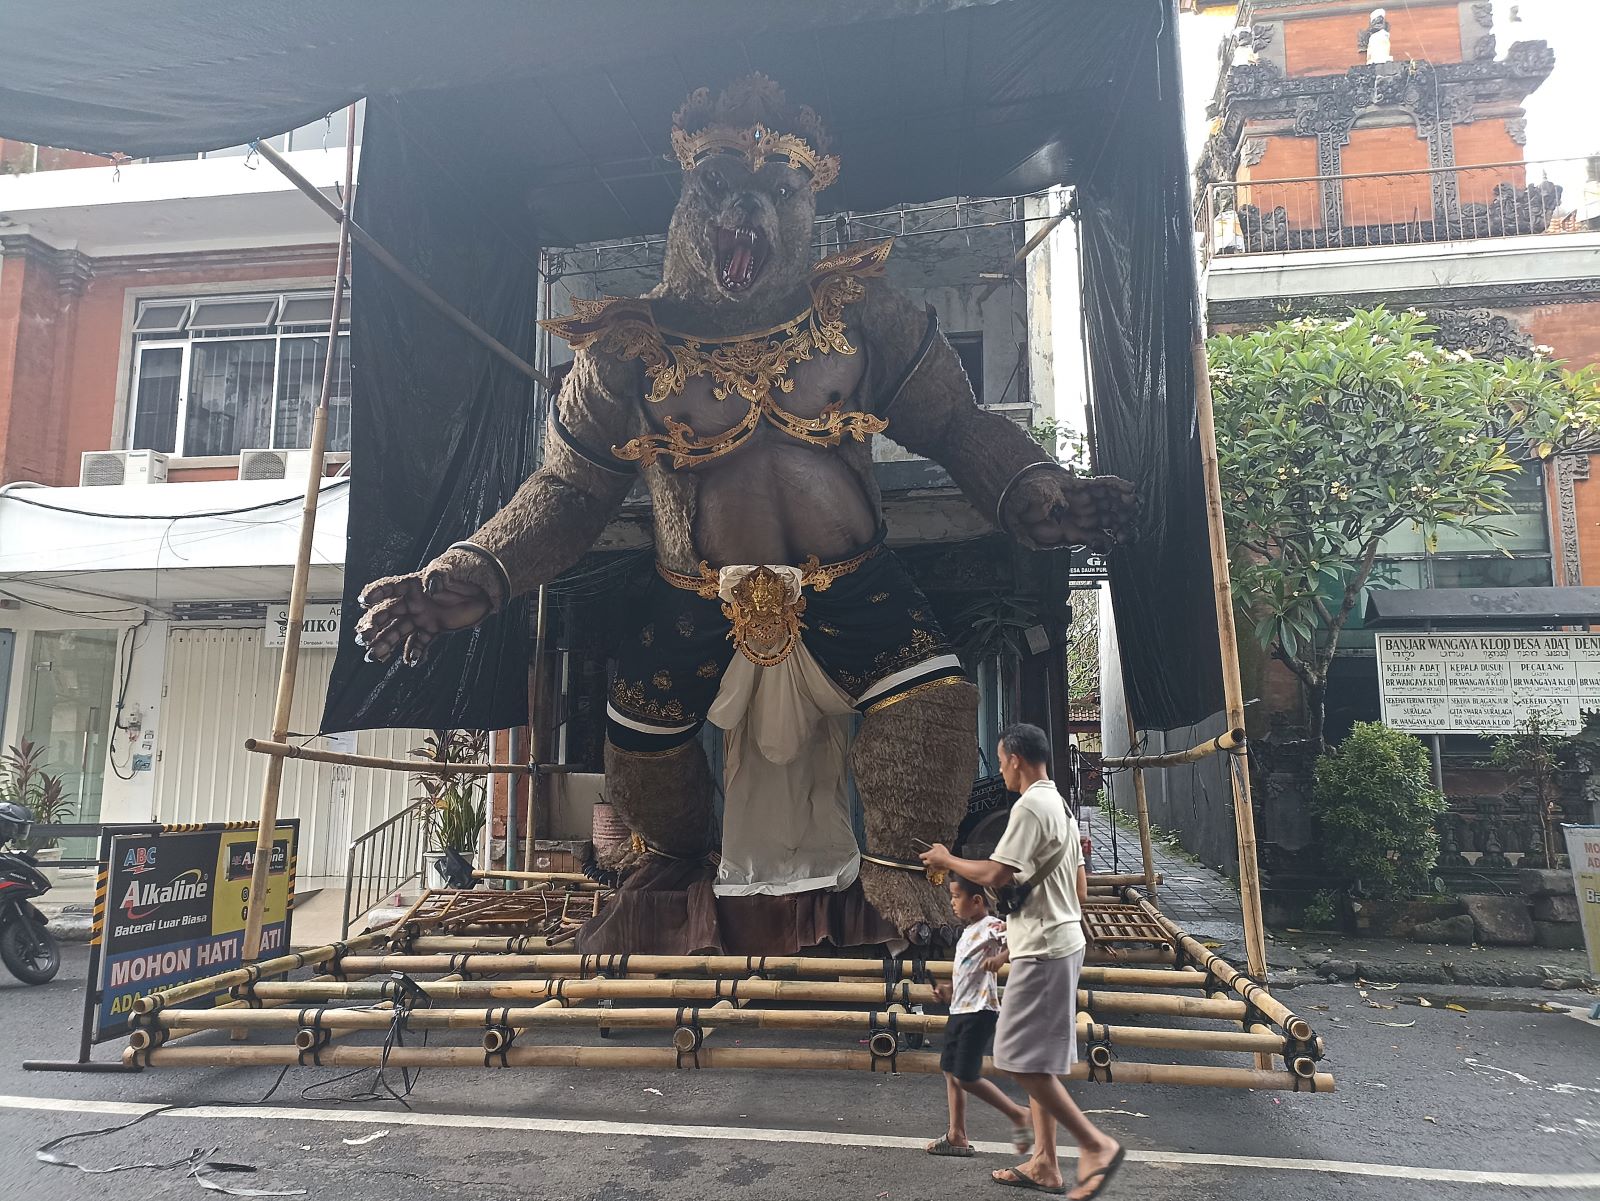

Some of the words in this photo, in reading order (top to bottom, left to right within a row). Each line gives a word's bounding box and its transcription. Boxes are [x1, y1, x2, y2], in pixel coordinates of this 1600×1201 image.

[1385, 639, 1426, 650] BANJAR
[1428, 639, 1478, 650] WANGAYA
[1480, 639, 1511, 650] KLOD
[1513, 638, 1541, 650] DESA
[1544, 638, 1570, 650] ADAT
[1575, 638, 1600, 650] DEN
[124, 846, 157, 866] ABC
[120, 880, 208, 909] Alkaline
[114, 921, 156, 937] Baterai
[157, 918, 180, 930] Luar
[181, 914, 207, 926] Biasa
[111, 948, 191, 987] MOHON
[197, 938, 237, 966] HATI
